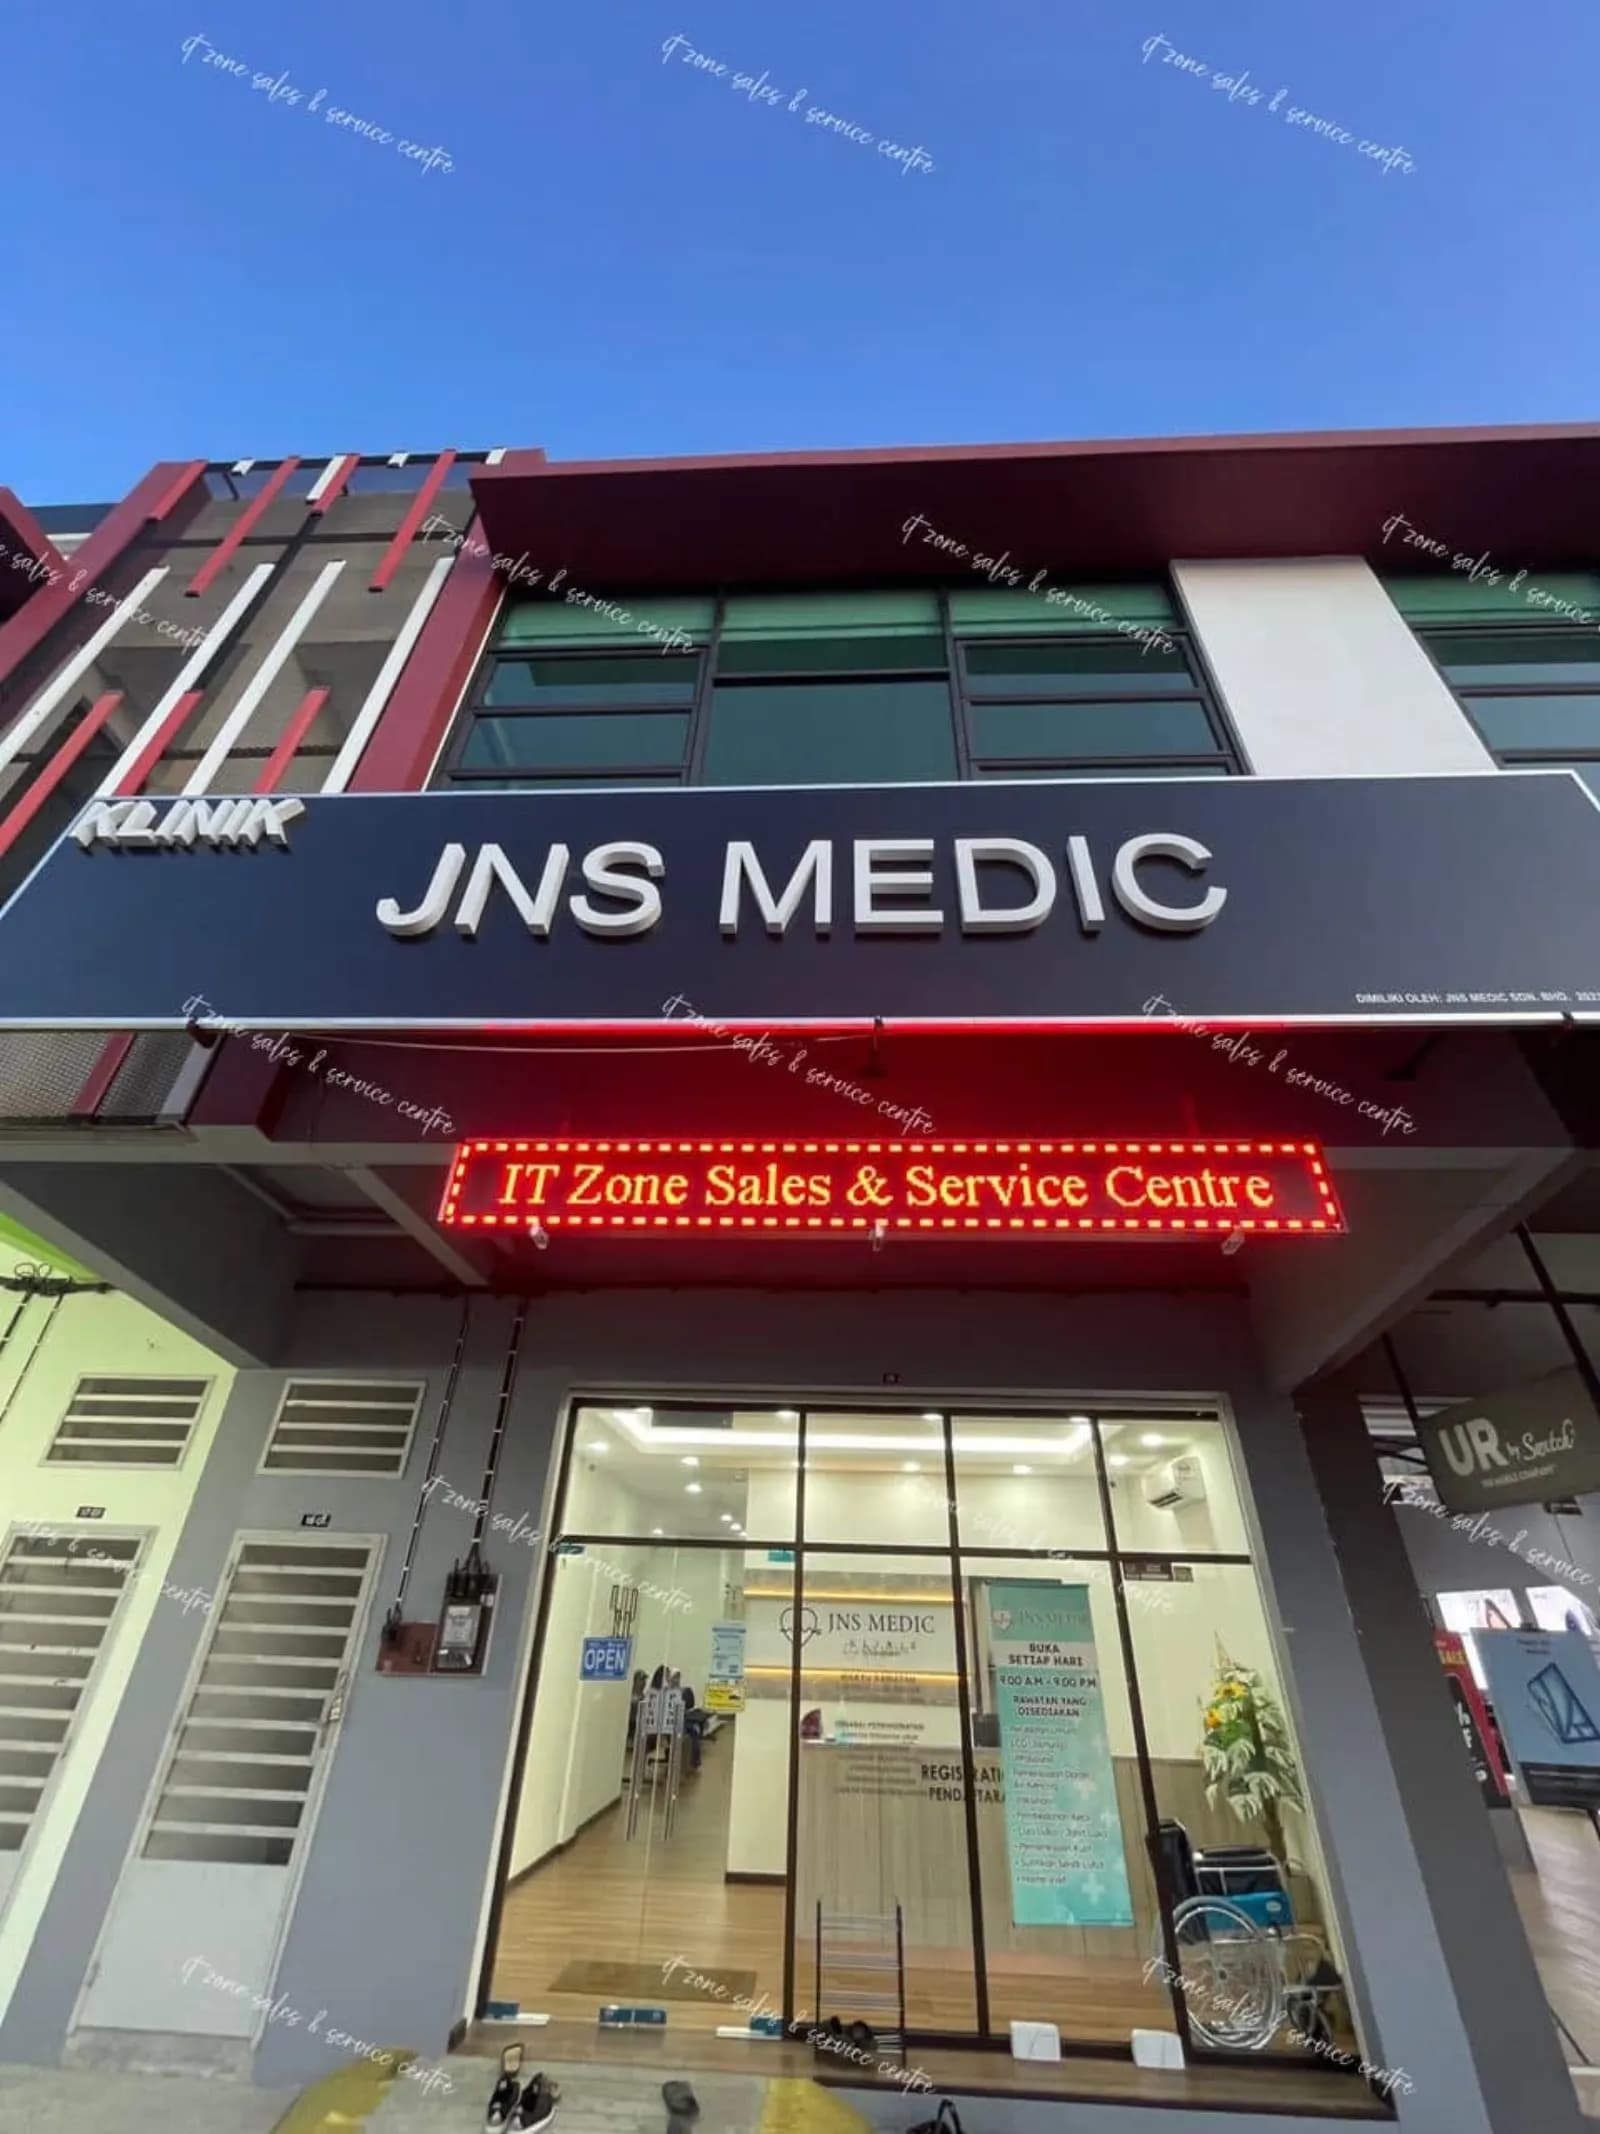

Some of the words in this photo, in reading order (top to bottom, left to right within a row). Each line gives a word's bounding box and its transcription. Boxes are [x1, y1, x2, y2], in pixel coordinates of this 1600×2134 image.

[68, 798, 305, 847] KLINIK
[376, 841, 664, 937] JNS
[719, 832, 1228, 935] MEDIC
[499, 1164, 559, 1205] IT
[568, 1164, 688, 1206] Zone
[705, 1163, 831, 1206] Sales
[846, 1165, 893, 1206] &
[906, 1163, 1088, 1206] Service
[1105, 1165, 1274, 1207] Centre
[1438, 1418, 1509, 1476] UR
[828, 1613, 861, 1632] JNS
[868, 1614, 935, 1633] MEDIC
[584, 1648, 626, 1670] OPEN
[1029, 1643, 1060, 1653] BUKA
